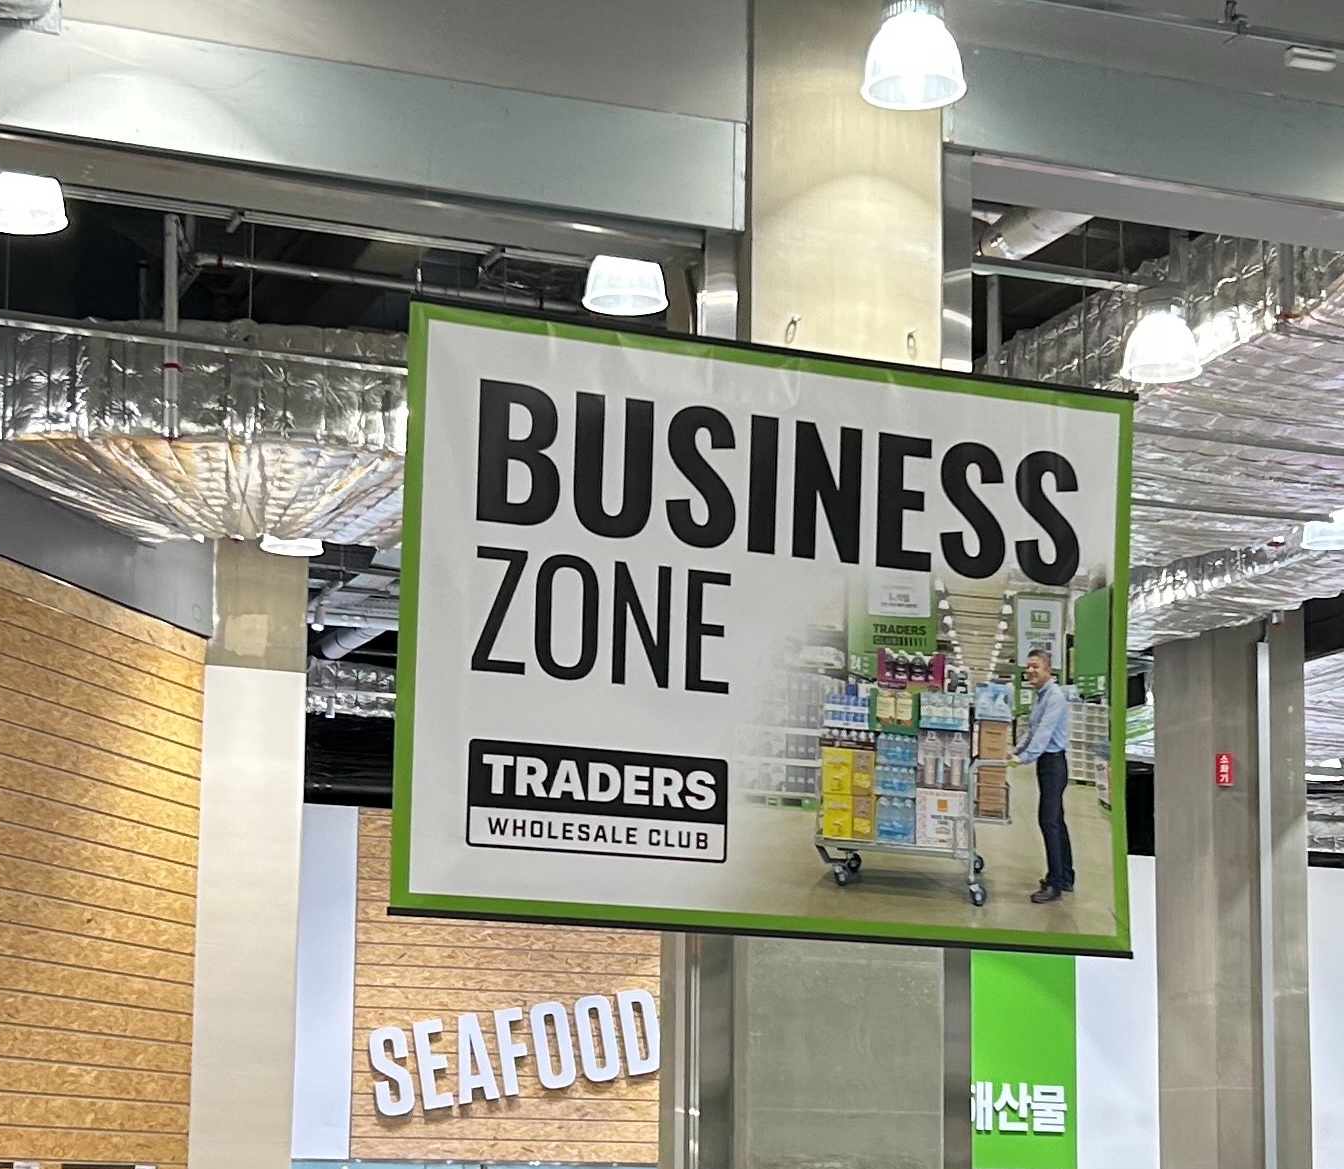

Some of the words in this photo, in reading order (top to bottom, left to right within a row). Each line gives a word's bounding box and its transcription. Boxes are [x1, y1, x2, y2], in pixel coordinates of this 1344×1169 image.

[475, 379, 1080, 588] BUSINESS
[470, 546, 733, 696] ZONE
[872, 623, 927, 636] TRADERS
[482, 753, 718, 812] TRADERS
[487, 817, 638, 847] WHOLESALE
[648, 825, 710, 852] CLUB
[367, 987, 660, 1118] SEAFOOD
